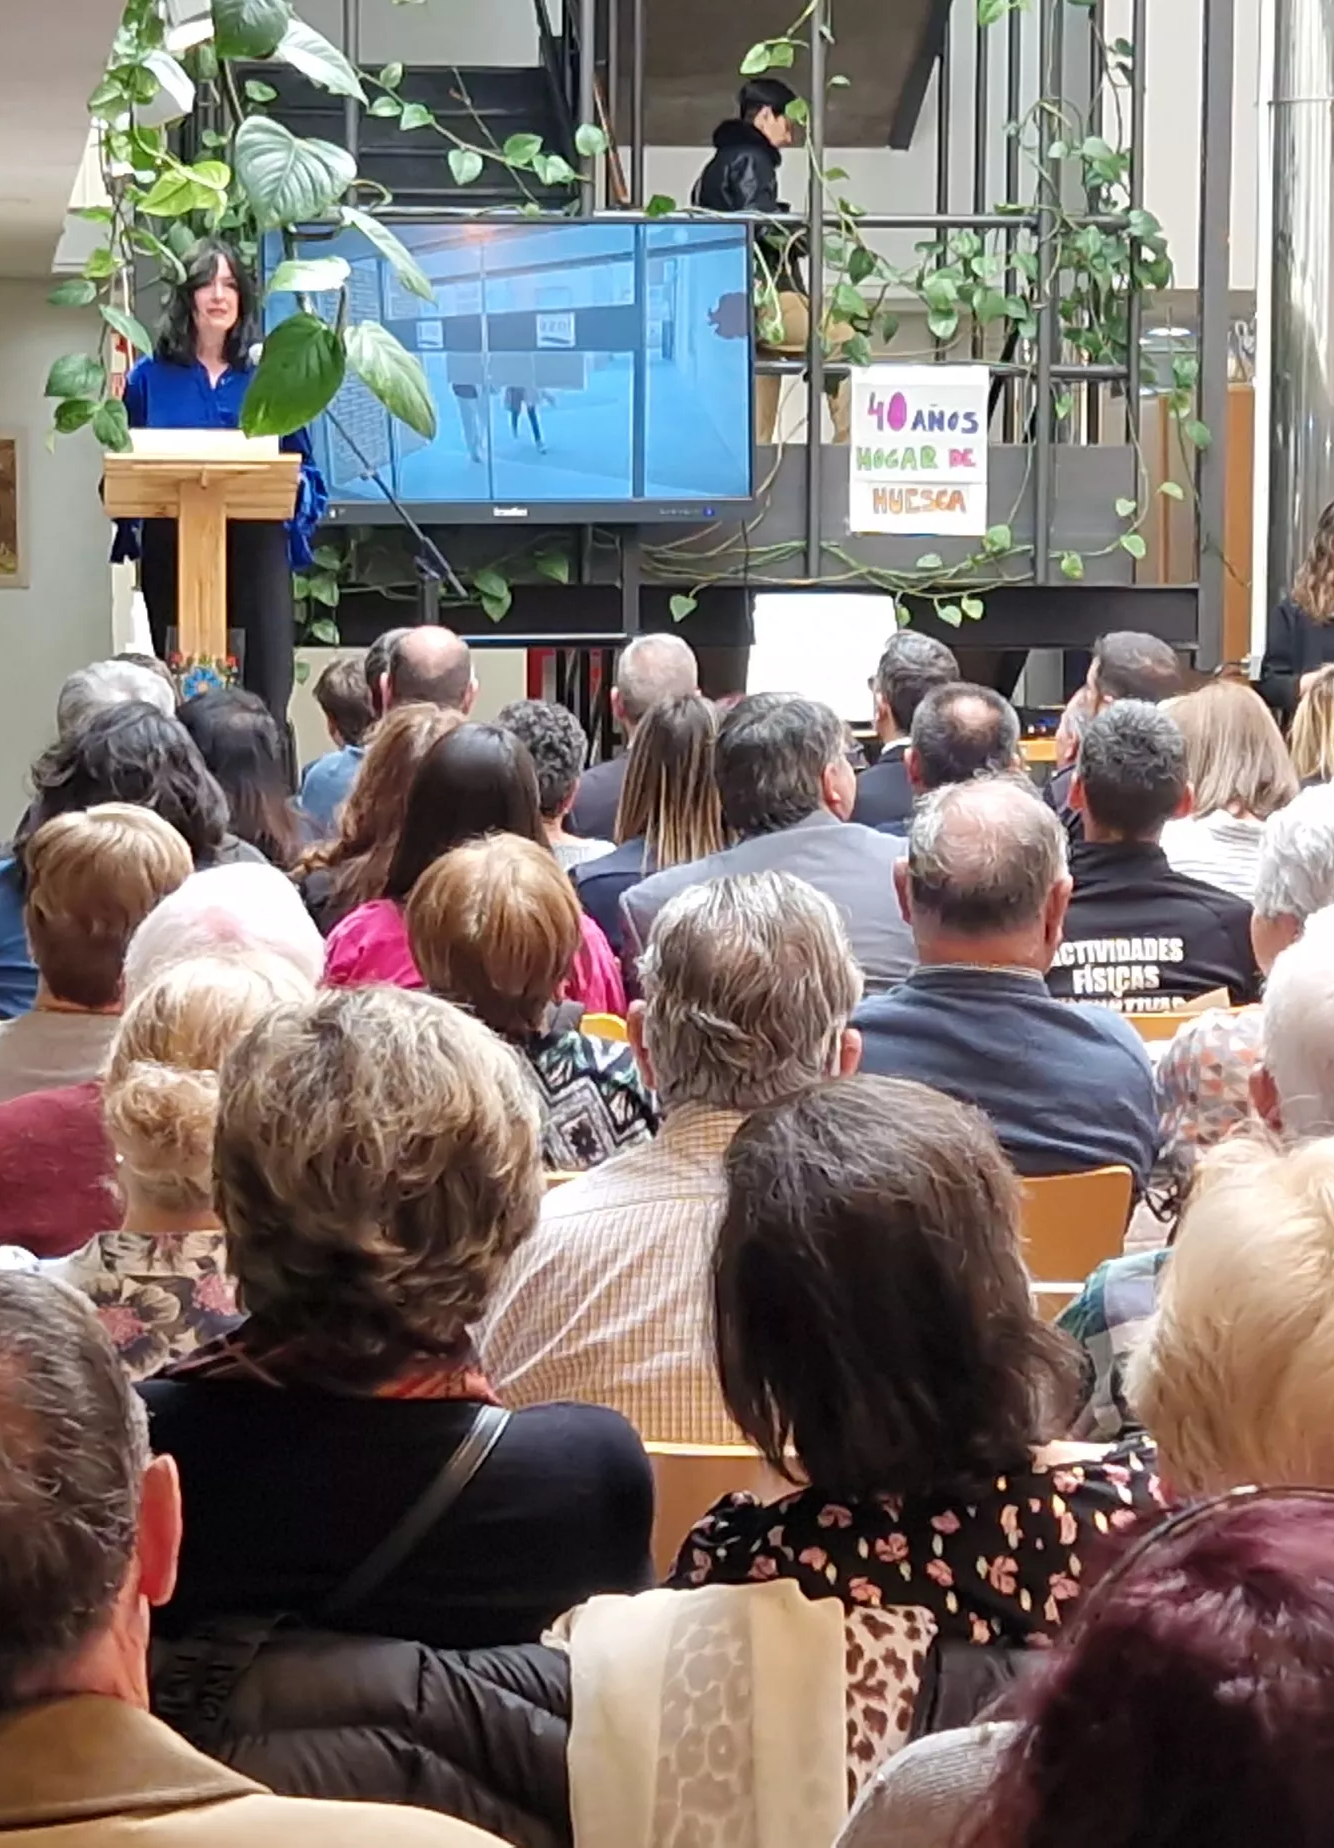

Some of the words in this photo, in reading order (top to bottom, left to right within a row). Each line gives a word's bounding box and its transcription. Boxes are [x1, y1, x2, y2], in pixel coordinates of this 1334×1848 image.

[867, 391, 908, 432] 40
[910, 403, 980, 435] AÑOS
[855, 445, 939, 471] HOGAR
[948, 448, 977, 469] DE
[872, 487, 968, 515] HUESCA
